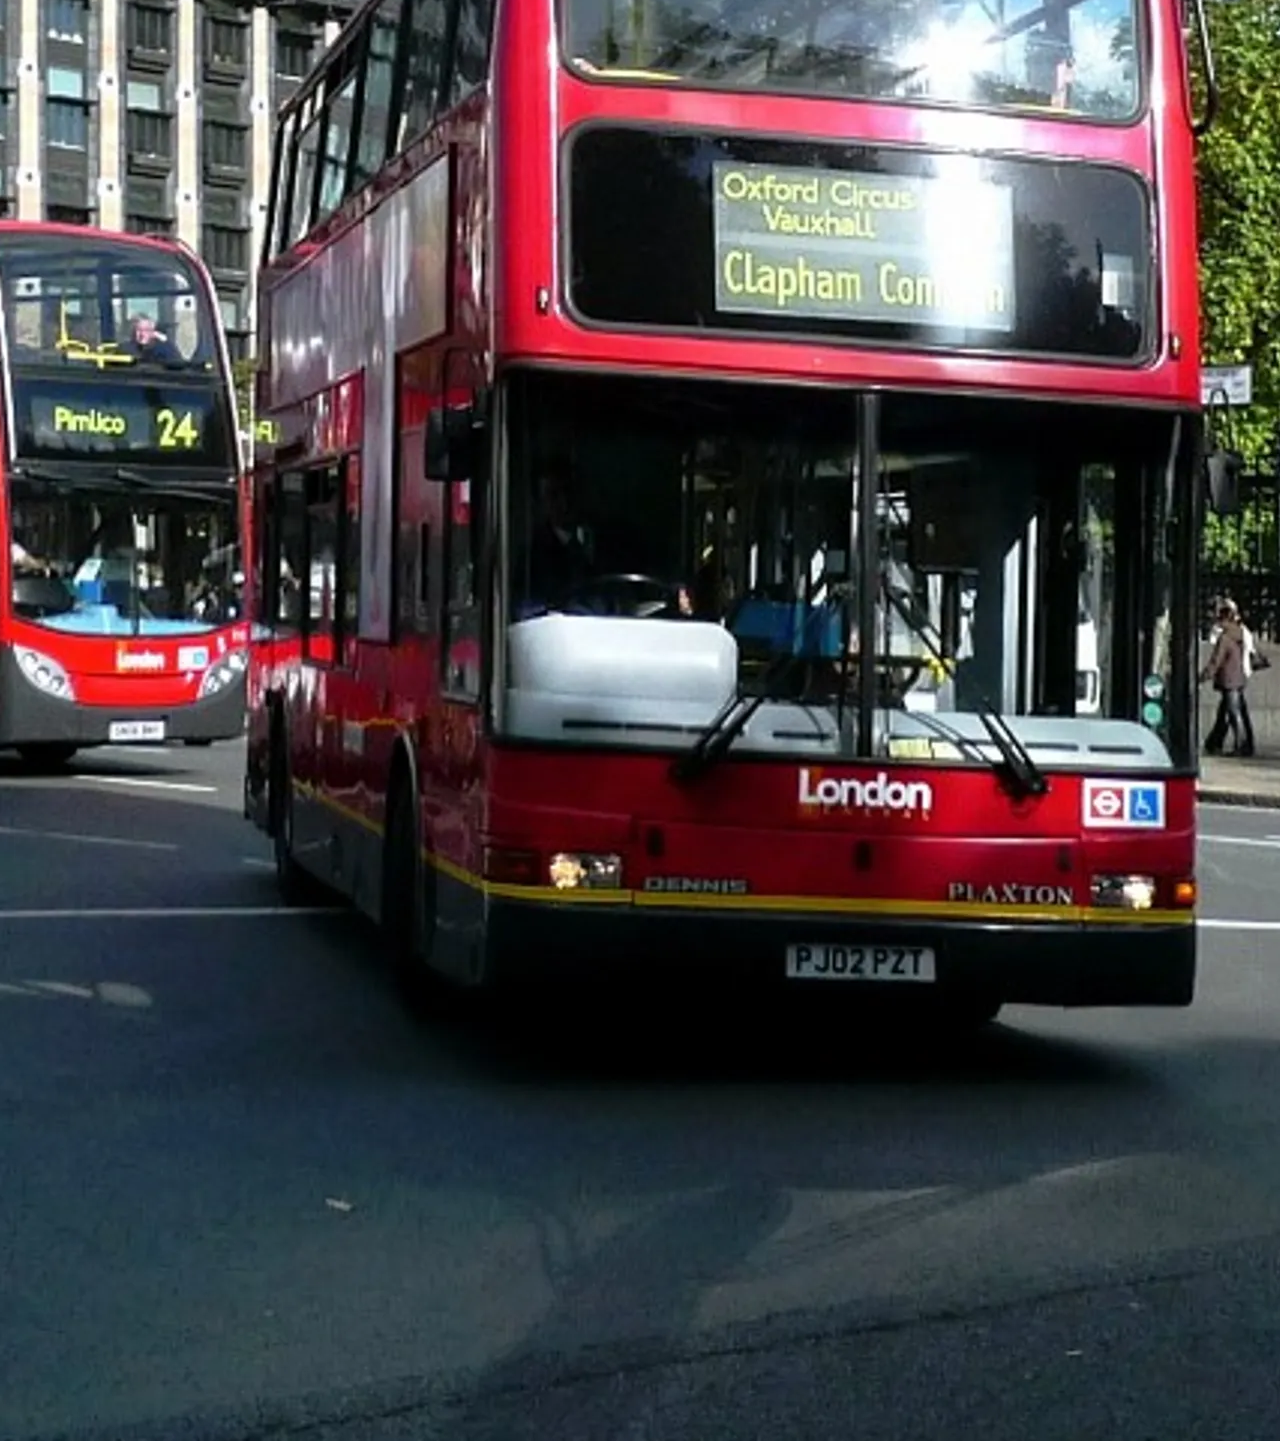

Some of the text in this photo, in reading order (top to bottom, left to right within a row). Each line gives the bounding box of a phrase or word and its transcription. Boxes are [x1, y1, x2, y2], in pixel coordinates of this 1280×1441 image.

[722, 172, 915, 209] Oxford Circus
[763, 205, 876, 238] Vauxhall
[724, 251, 861, 305] Clapham
[54, 405, 198, 447] Pimlico 24
[799, 767, 933, 810] London
[644, 875, 748, 894] DENNIS
[947, 880, 1074, 905] PLAXTON
[795, 946, 923, 975] PJ02 PZT
